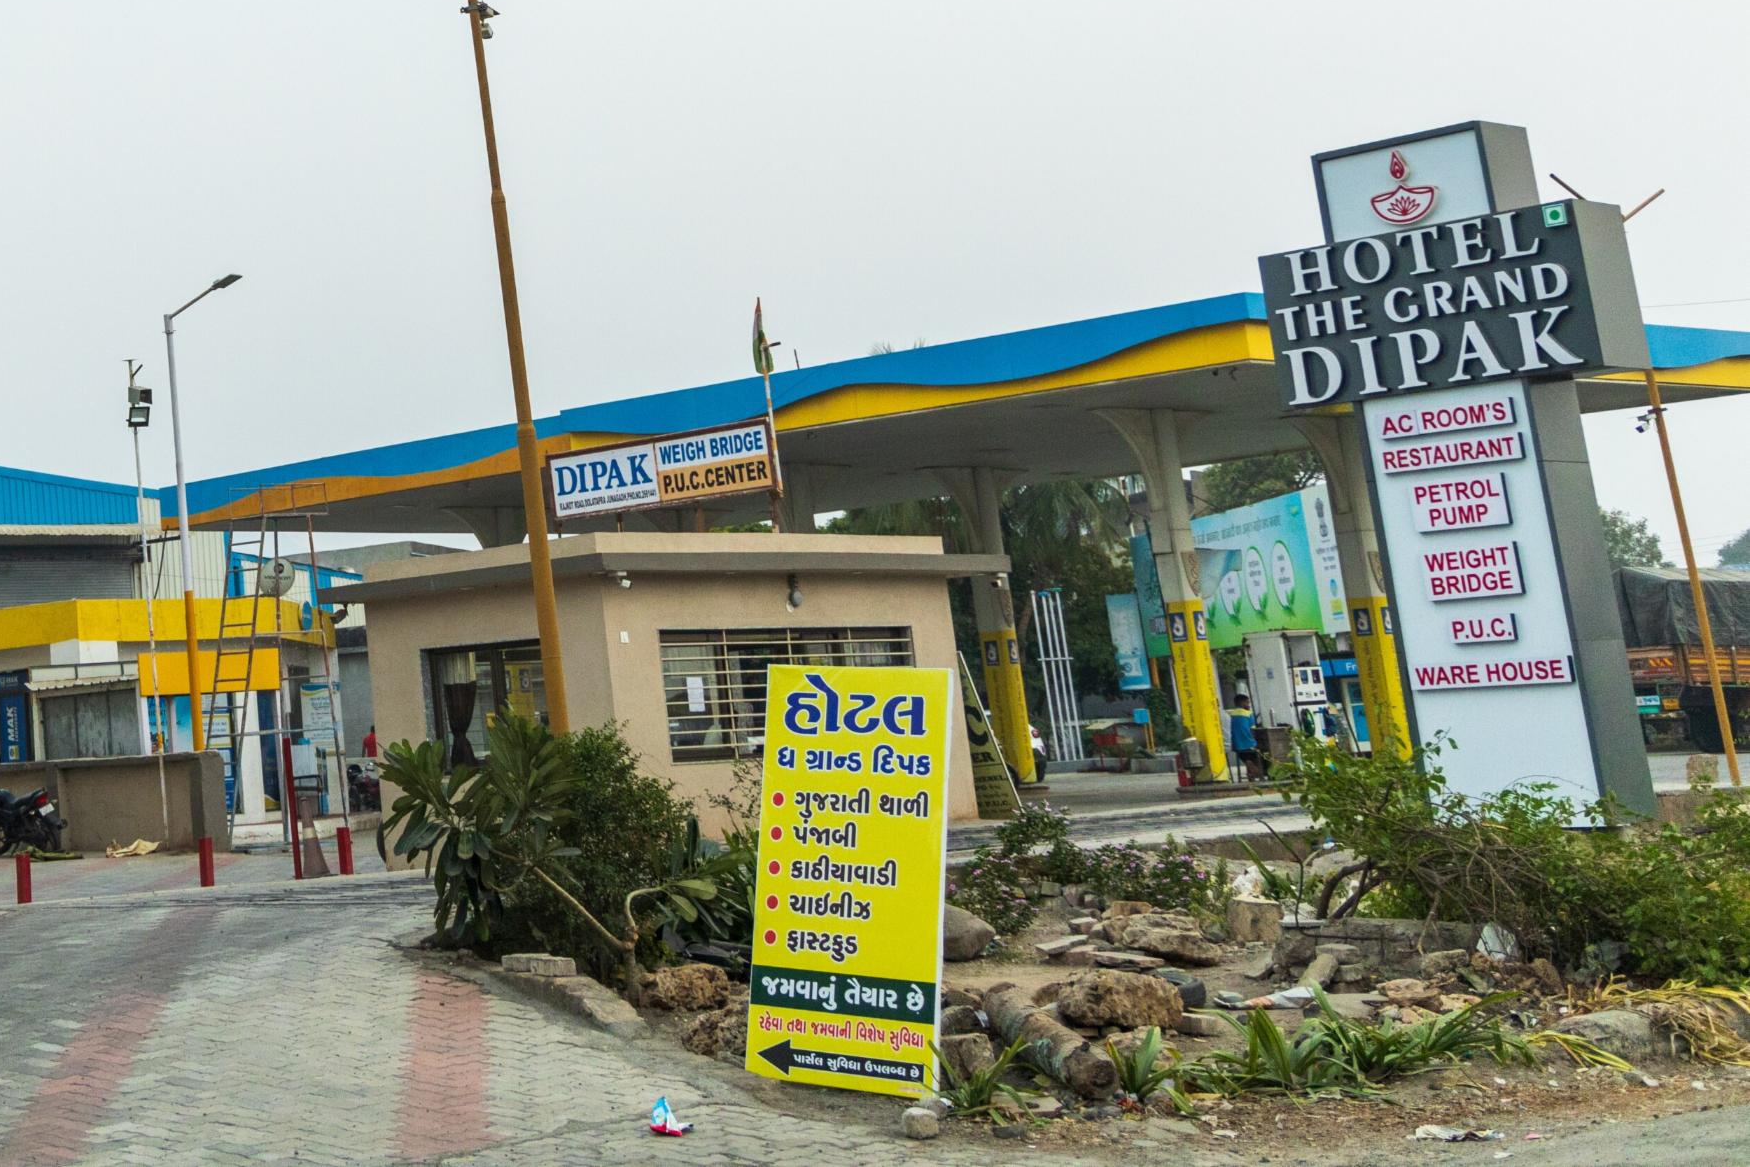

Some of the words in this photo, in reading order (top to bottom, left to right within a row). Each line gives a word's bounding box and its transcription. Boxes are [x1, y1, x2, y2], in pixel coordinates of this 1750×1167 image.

[1284, 211, 1540, 297] HOTEL
[1275, 295, 1367, 341] THE
[1383, 262, 1569, 324] GRAND
[1282, 305, 1585, 406] DIPAK
[1382, 415, 1414, 436] AC
[1421, 402, 1507, 432] ROOM'S
[659, 441, 706, 465] WEIGH
[710, 430, 764, 456] BRIDGE
[1382, 437, 1515, 470] RESTAURANT
[554, 453, 653, 496] DIPAK
[1414, 479, 1500, 505] PETROL
[1429, 503, 1489, 527] PUMP
[1424, 546, 1509, 573] WEIGHT
[1430, 569, 1514, 596] BRIDGE
[1452, 617, 1513, 641] P.U.C.
[1415, 664, 1480, 686] WARE
[1485, 658, 1565, 683] HOUSE
[784, 674, 927, 735] હોટલ
[778, 746, 795, 768] ધ
[806, 750, 862, 772] ગ્રાન્ડ
[872, 745, 931, 776] દિપક
[795, 788, 870, 819] ગુજરાતી
[879, 791, 929, 817] થાળી
[793, 819, 857, 848] પંજાબી
[791, 855, 897, 886] કાઠીયાવાડી
[787, 930, 858, 962] ફાસ્ટફુડ
[761, 976, 837, 1011] જમવાનું
[844, 977, 898, 1009] તૈયાર
[906, 984, 925, 1012] છે
[759, 1012, 782, 1032] રહેવા
[787, 1018, 806, 1034] તથા
[811, 1020, 851, 1040] જમવાની
[856, 1021, 885, 1043] વિશેષ
[889, 1026, 924, 1052] સુવિધા
[793, 1052, 823, 1066] પાર્સલ
[827, 1057, 861, 1071] સુવિધા
[864, 1060, 906, 1077] ઉપલબ્ધ
